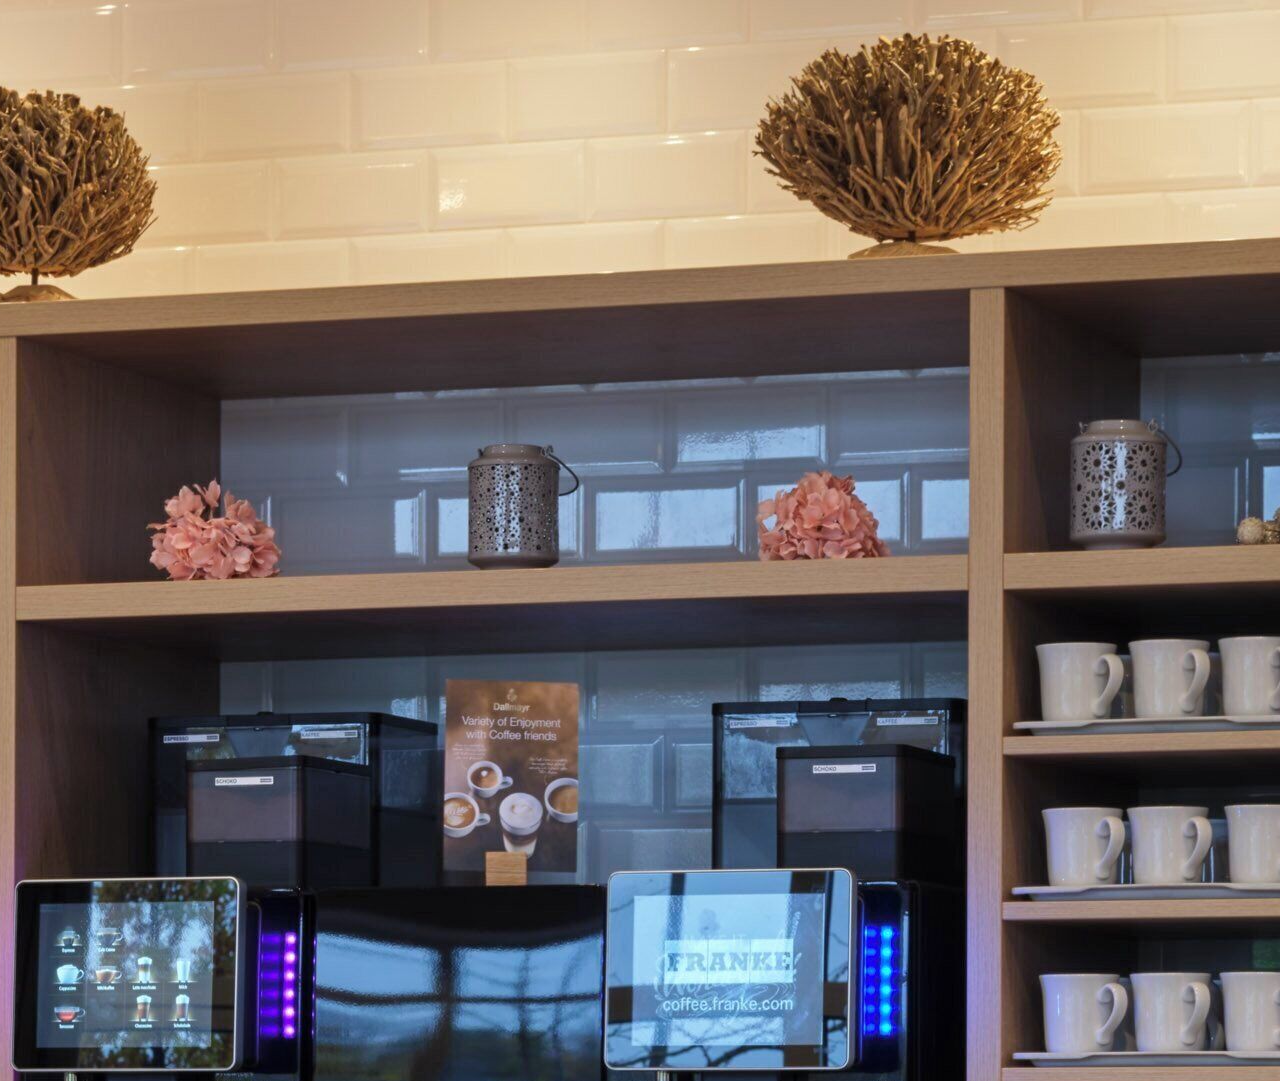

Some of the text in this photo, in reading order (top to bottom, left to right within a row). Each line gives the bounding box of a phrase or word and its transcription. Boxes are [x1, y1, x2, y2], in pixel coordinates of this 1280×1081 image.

[493, 702, 531, 713] Dallmayr
[462, 715, 561, 729] Variety of Enjoyment
[466, 729, 557, 741] with Coffee friends
[813, 765, 837, 773] SCHOKO
[666, 952, 791, 972] FRANKE
[662, 997, 794, 1012] coffee.franke.com
